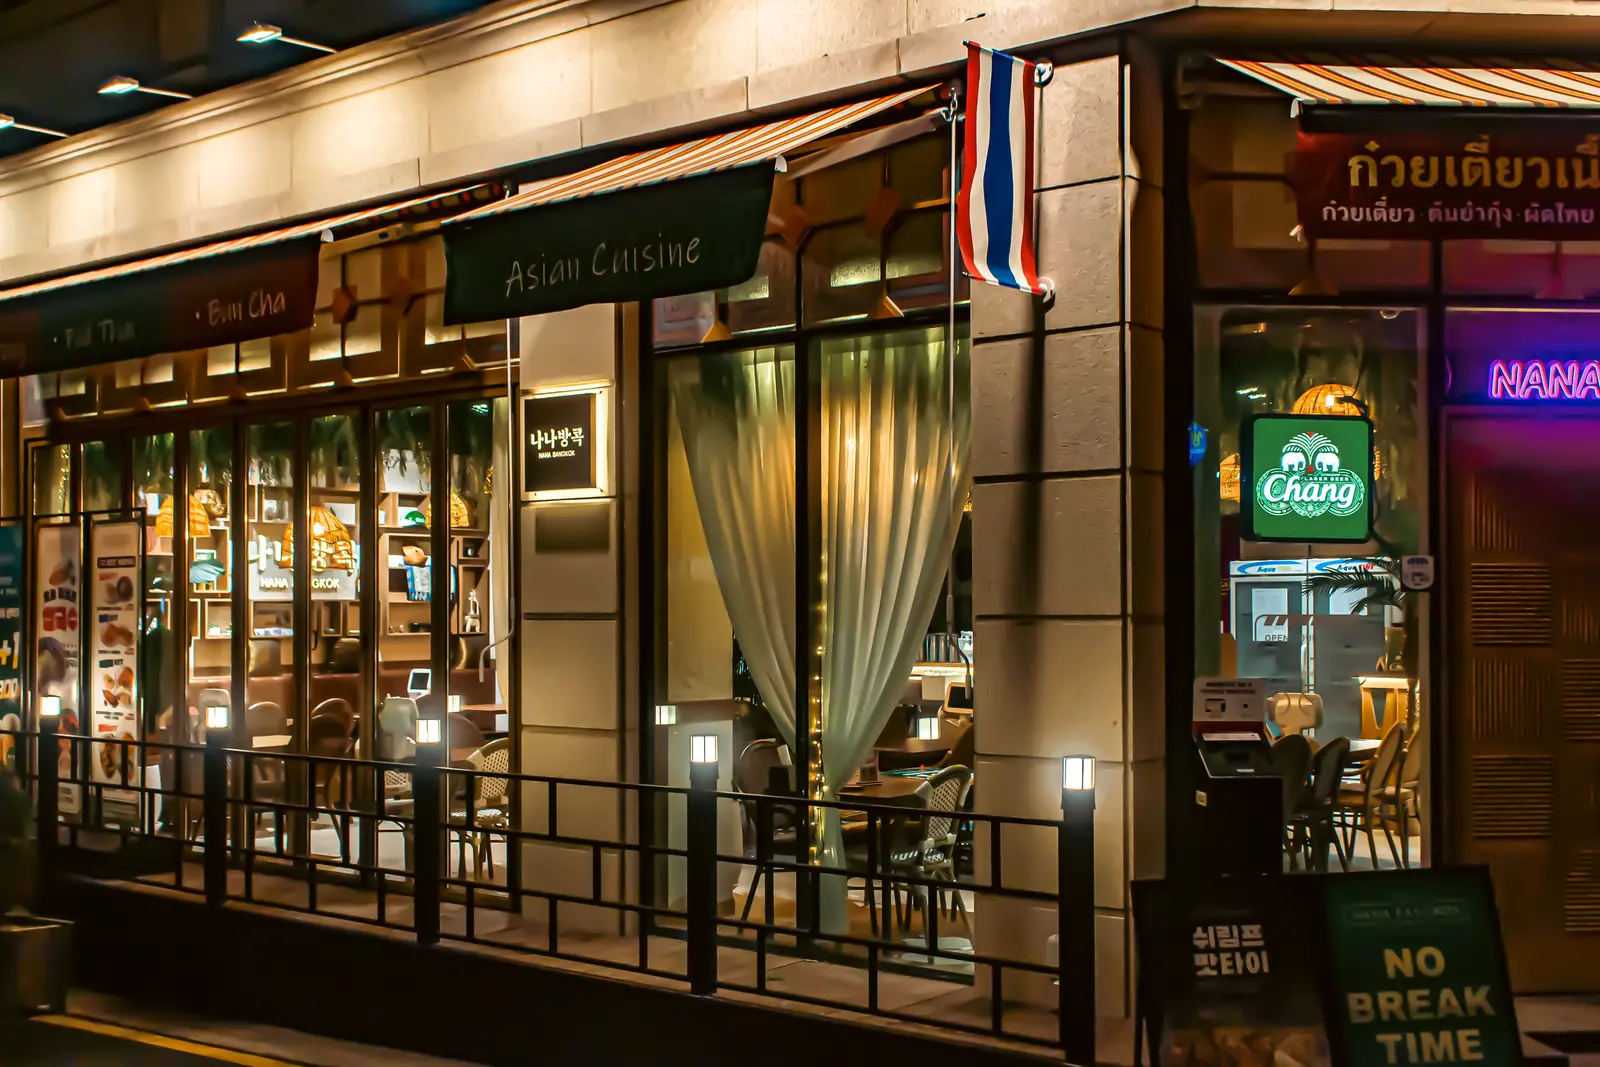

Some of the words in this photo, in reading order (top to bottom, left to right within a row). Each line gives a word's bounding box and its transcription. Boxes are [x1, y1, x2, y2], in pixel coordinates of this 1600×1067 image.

[504, 253, 579, 297] Asian
[592, 233, 700, 276] Cuisine
[1488, 359, 1600, 399] NANA
[530, 427, 584, 450] 나나방콕
[538, 451, 552, 459] NANA
[552, 450, 576, 458] BANGKOK
[1263, 473, 1356, 509] Chang
[260, 577, 289, 589] NANA
[1193, 924, 1265, 949] 쉬림프
[1384, 945, 1446, 980] NO
[1346, 984, 1497, 1024] BREAK
[1375, 1028, 1486, 1065] TIME
